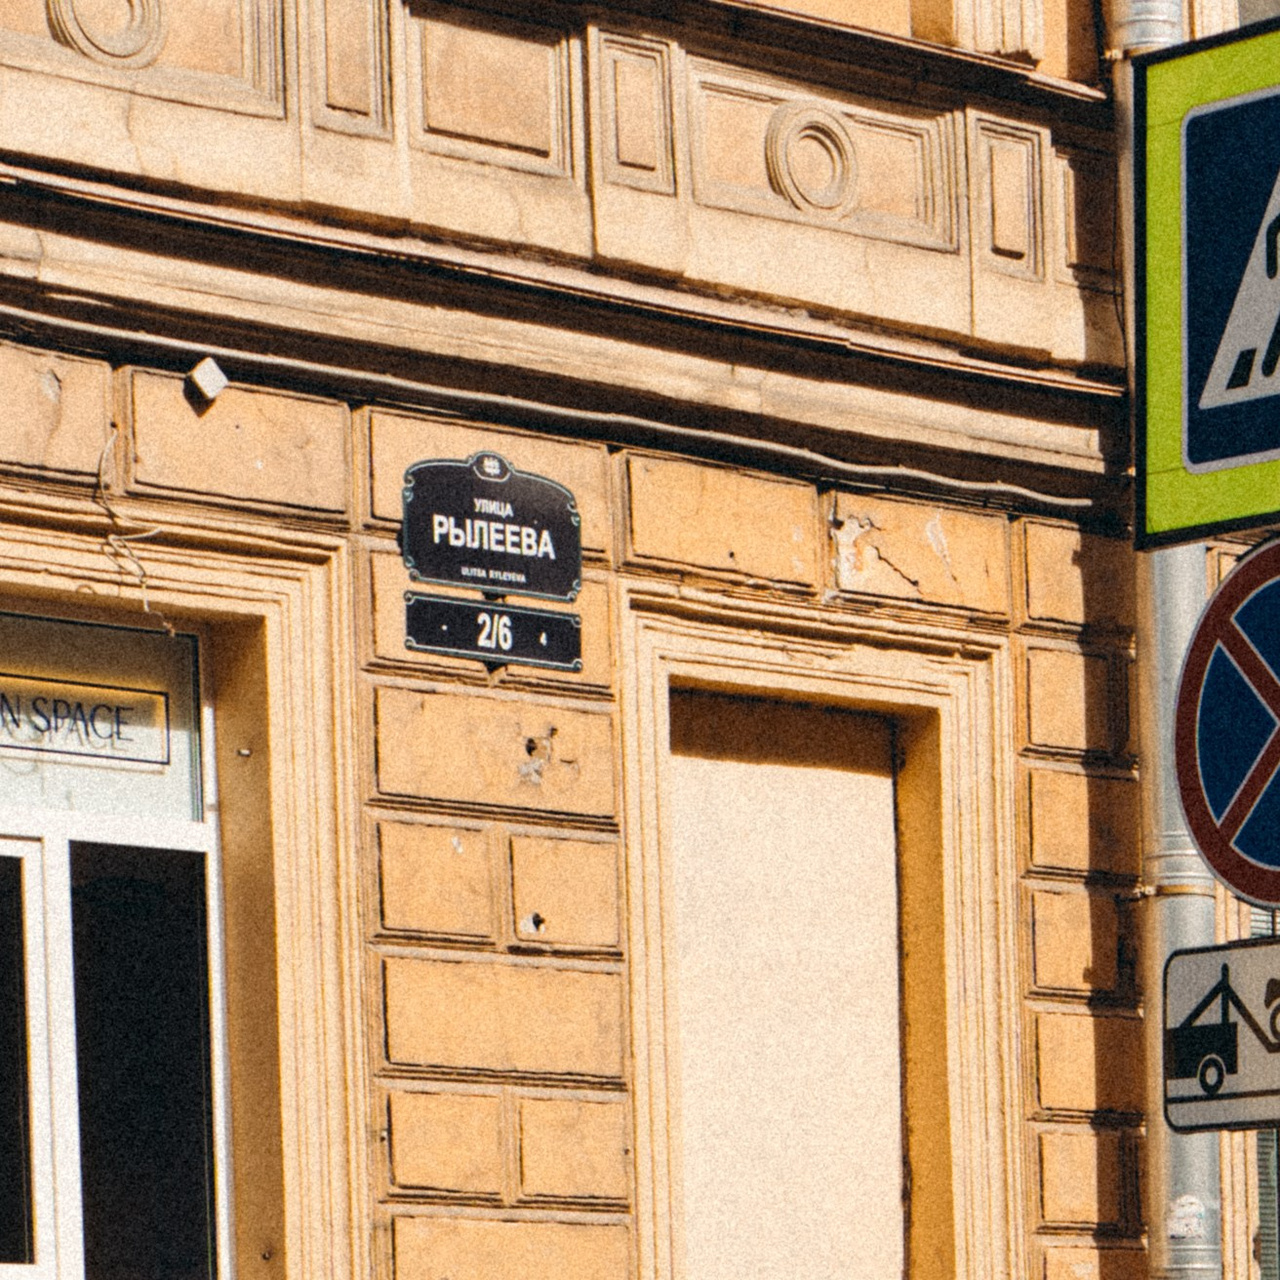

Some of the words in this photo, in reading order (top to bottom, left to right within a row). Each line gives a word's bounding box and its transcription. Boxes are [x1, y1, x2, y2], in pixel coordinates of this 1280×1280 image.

[473, 497, 514, 518] УЛИЦА
[432, 513, 556, 560] РЫЛЕЕВА
[477, 612, 513, 651] 2/6
[32, 696, 134, 741] SPACE
